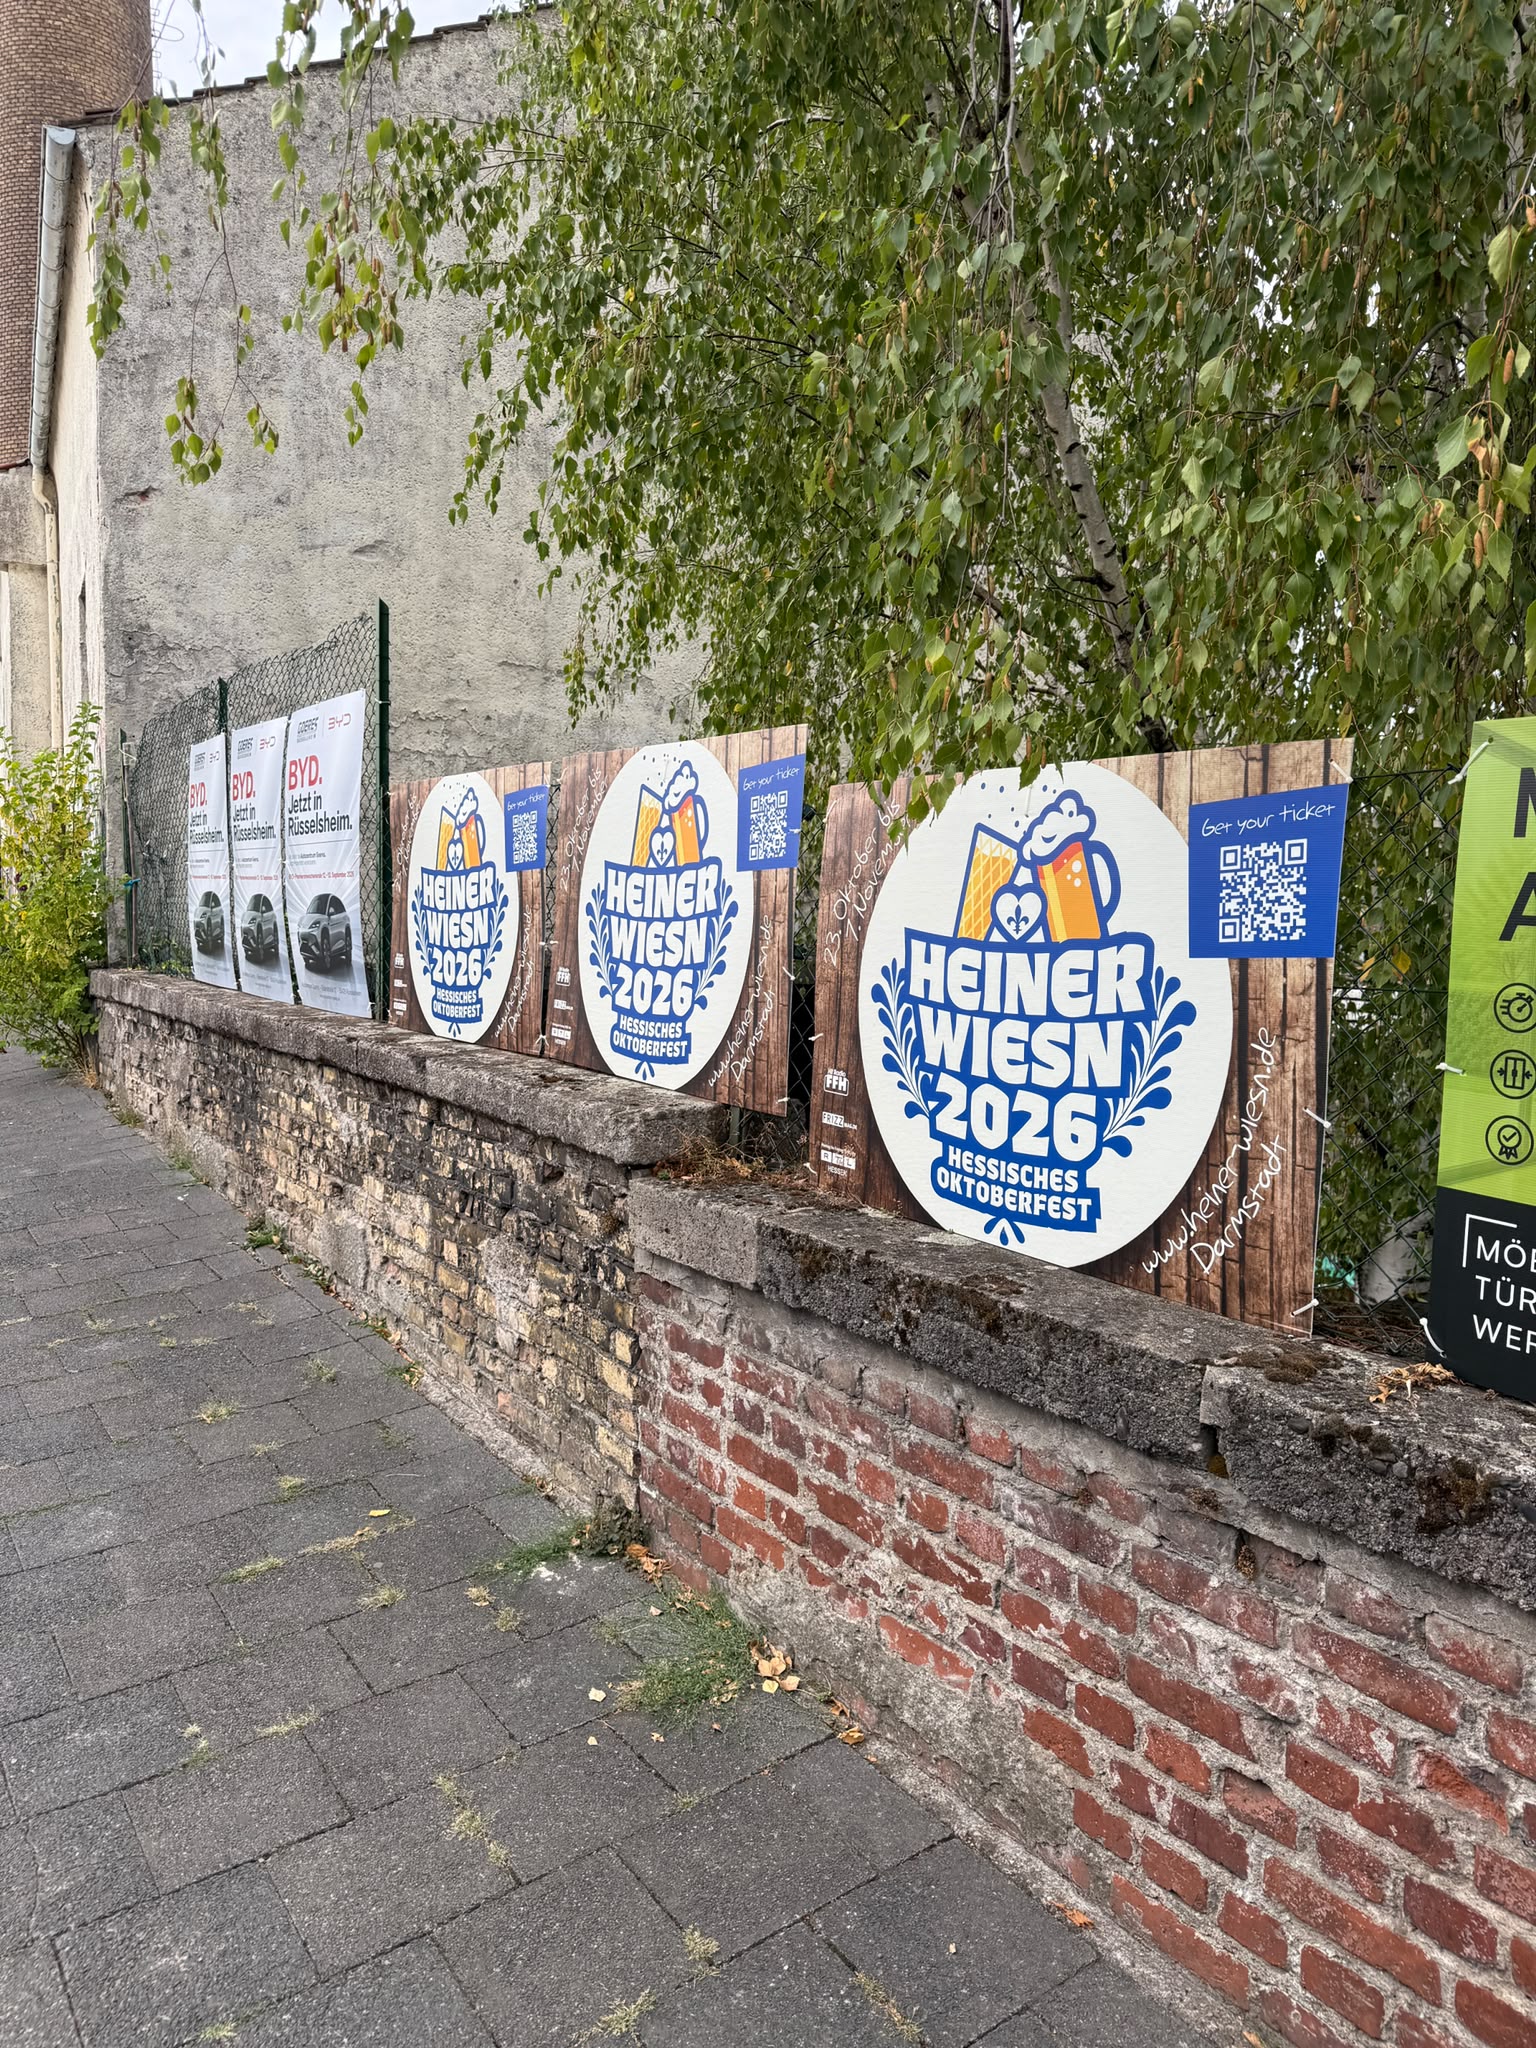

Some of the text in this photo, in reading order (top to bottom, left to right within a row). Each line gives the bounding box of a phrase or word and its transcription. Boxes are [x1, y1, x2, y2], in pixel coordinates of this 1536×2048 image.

[232, 771, 256, 801] BYD.
[288, 754, 323, 790] BYD.
[743, 765, 800, 791] Get your ticket
[190, 782, 207, 809] BYD.
[233, 802, 256, 822] Jetzt in
[288, 791, 322, 815] Jetzt in
[565, 788, 589, 857] Oktober
[588, 768, 602, 788] bis
[576, 774, 608, 855] November
[233, 821, 277, 842] Rüsselsheim.
[288, 811, 353, 837] Rüsselsheim.
[1201, 801, 1336, 837] Get your ticket
[423, 867, 495, 911] HEINER
[606, 863, 718, 918] HEINER
[823, 798, 901, 967] 23. Oktober bis
[426, 908, 489, 948] WIESN
[610, 916, 708, 968] WIESN
[845, 918, 862, 941] 7.
[431, 948, 482, 986] 2026
[910, 940, 1145, 1017] HEINER
[434, 1001, 481, 1018] OKTOBERFEST
[436, 988, 477, 1003] HESSISCHES
[612, 963, 693, 1017] 2026
[613, 1029, 688, 1058] OKTOBERFEST
[619, 1015, 682, 1039] HESSISCHES
[730, 985, 776, 1082] Darmstadt
[918, 1005, 1124, 1088] WIESN
[826, 1075, 847, 1092] FFH
[928, 1071, 1098, 1162] 2026
[948, 1146, 1079, 1193] HESSISCHES
[1142, 1026, 1277, 1274] www.heiner-wiesn.de
[936, 1166, 1092, 1222] OKTOBERFEST
[1190, 1134, 1287, 1275] Darmstadt
